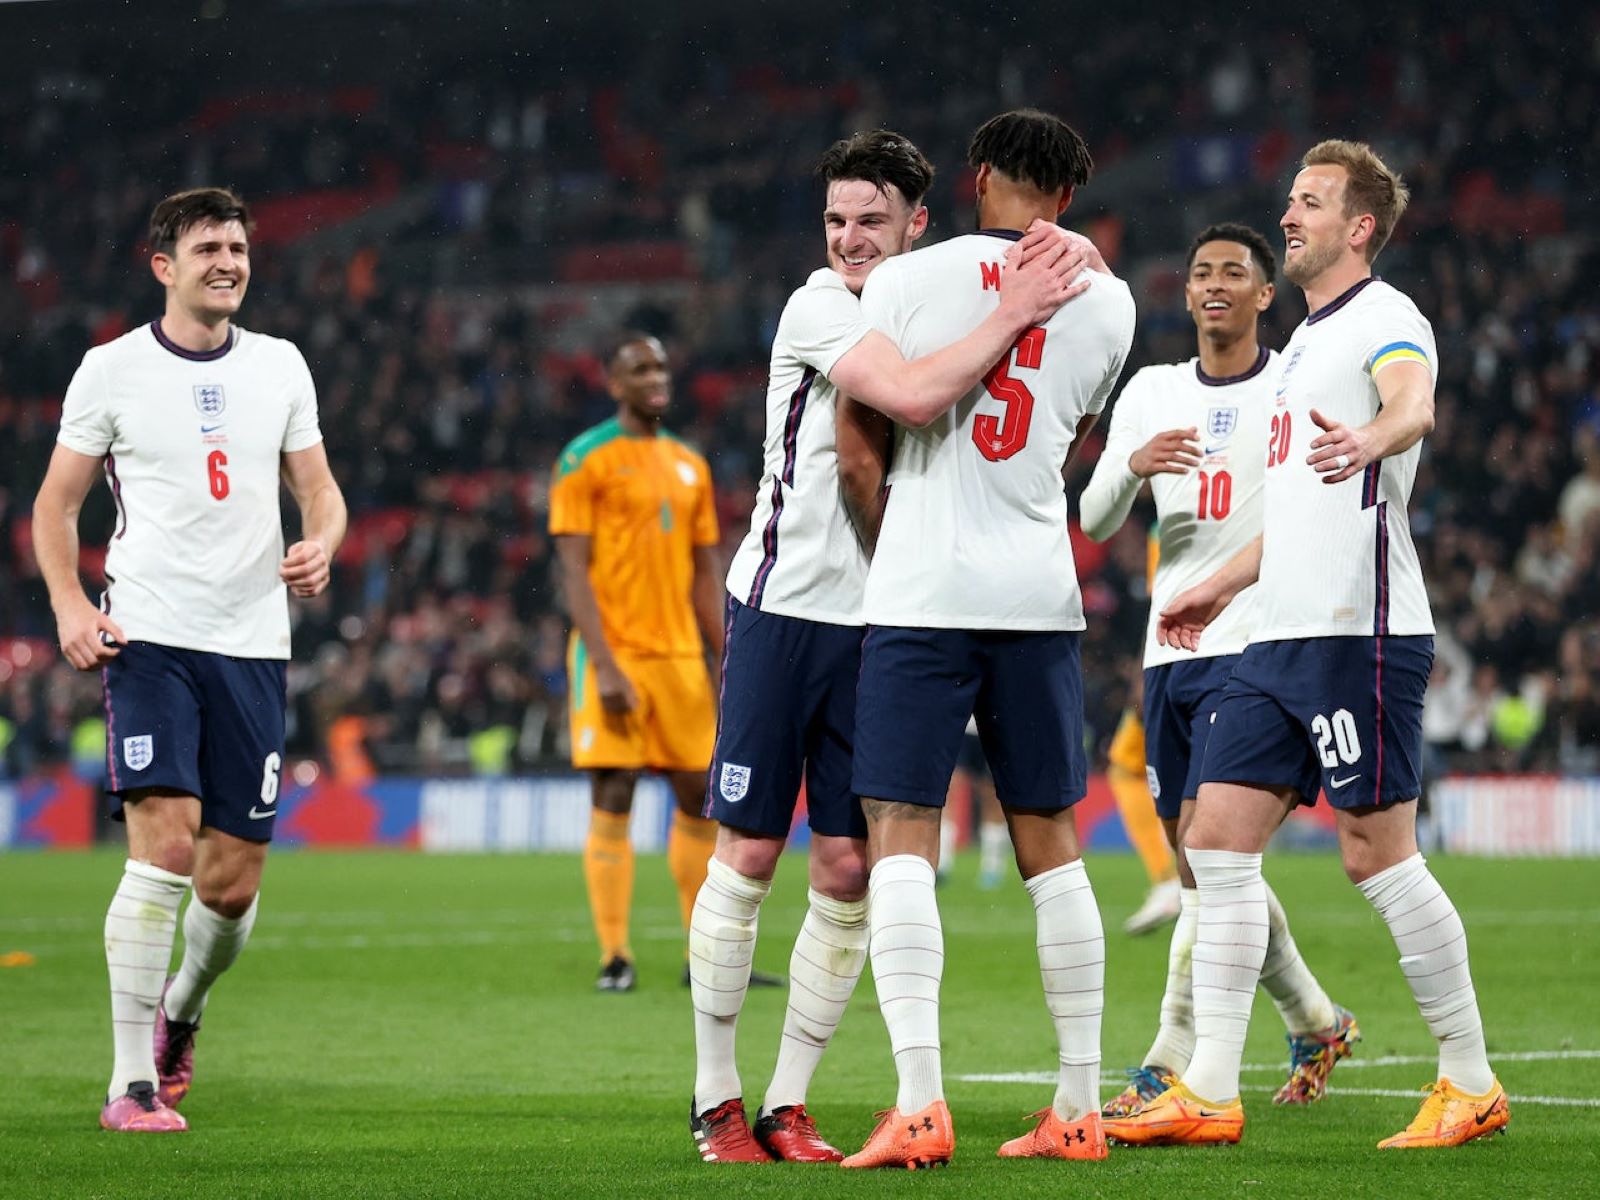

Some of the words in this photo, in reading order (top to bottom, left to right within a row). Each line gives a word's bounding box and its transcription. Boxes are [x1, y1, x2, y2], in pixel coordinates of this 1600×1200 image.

[972, 326, 1047, 462] 5
[1267, 410, 1292, 468] 20
[207, 450, 230, 501] 6
[1197, 471, 1232, 520] 10
[1311, 708, 1362, 768] 20
[261, 751, 281, 805] 6
